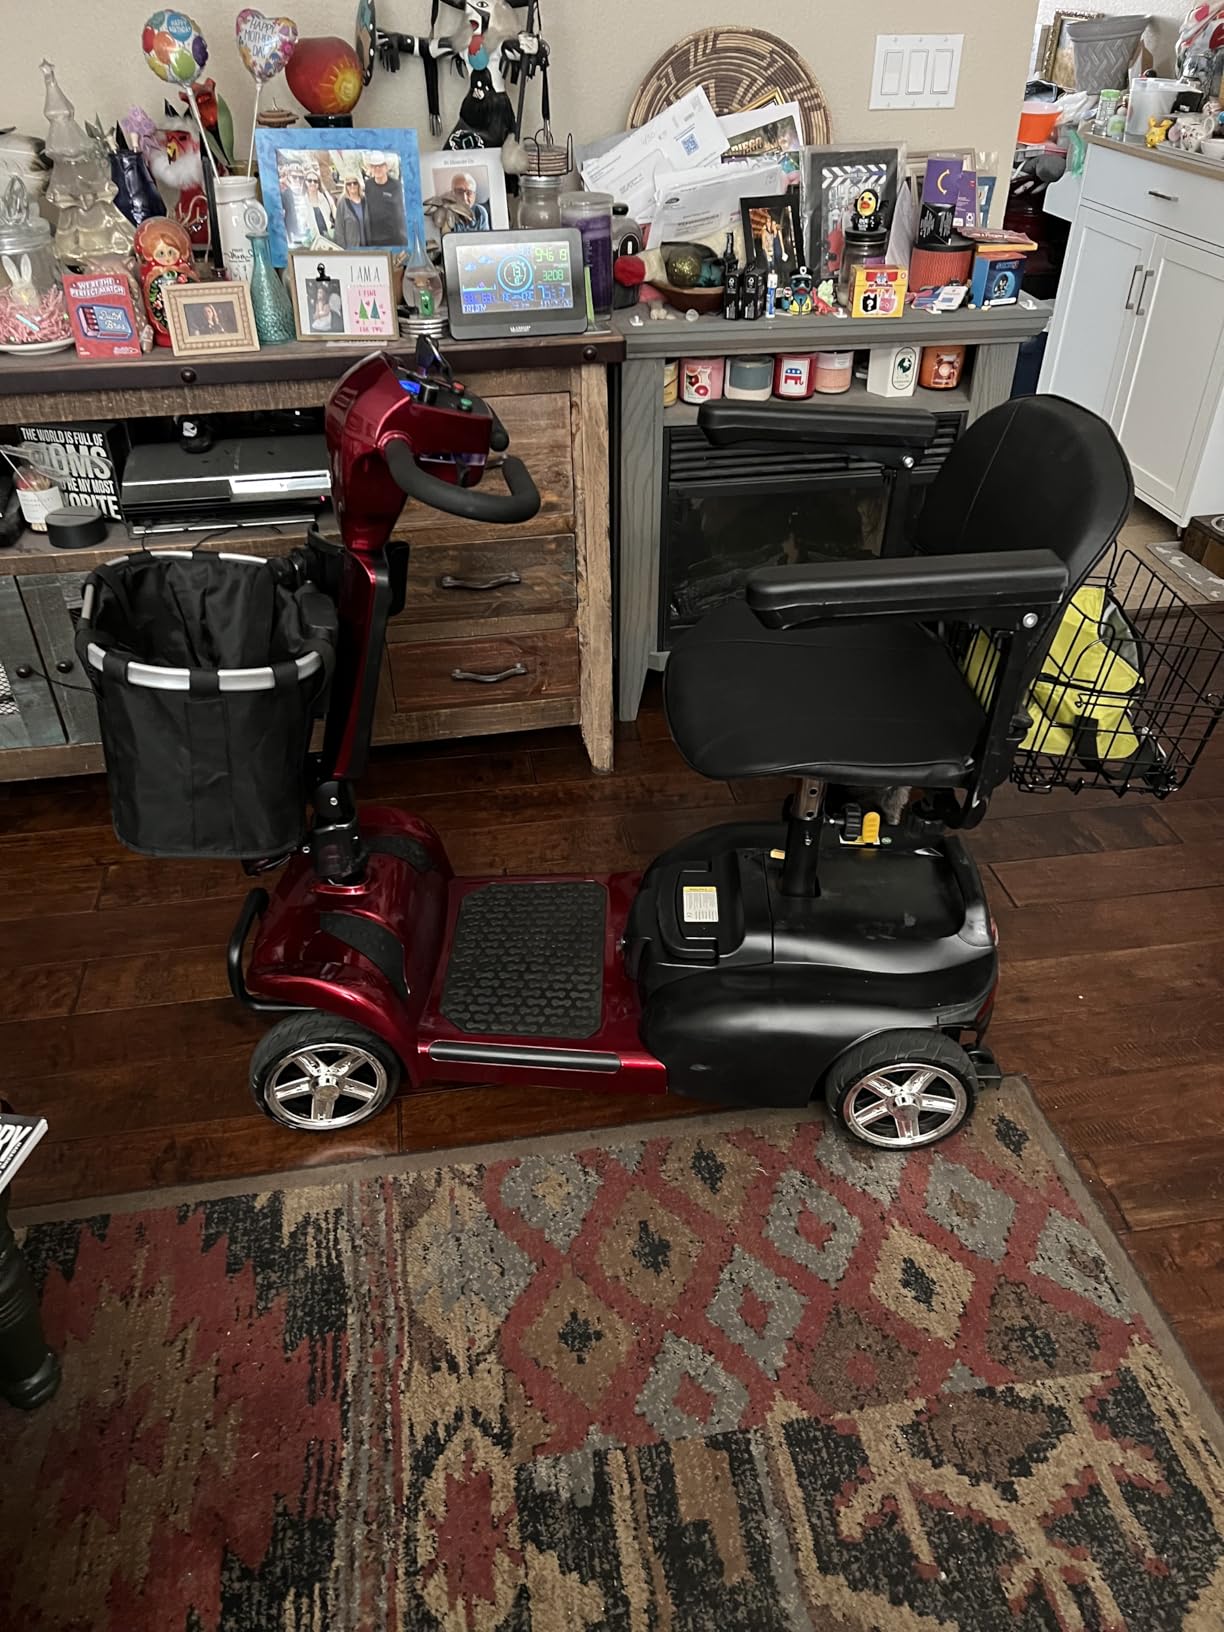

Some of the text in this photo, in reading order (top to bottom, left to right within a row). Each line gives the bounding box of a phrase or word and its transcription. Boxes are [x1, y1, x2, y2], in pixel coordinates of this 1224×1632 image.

[249, 18, 276, 34] HAPPY
[357, 265, 372, 282] AM
[374, 267, 381, 282] A
[20, 427, 103, 446] THE WORLD IS FULL OF
[77, 478, 91, 492] MY
[90, 479, 115, 494] MOST
